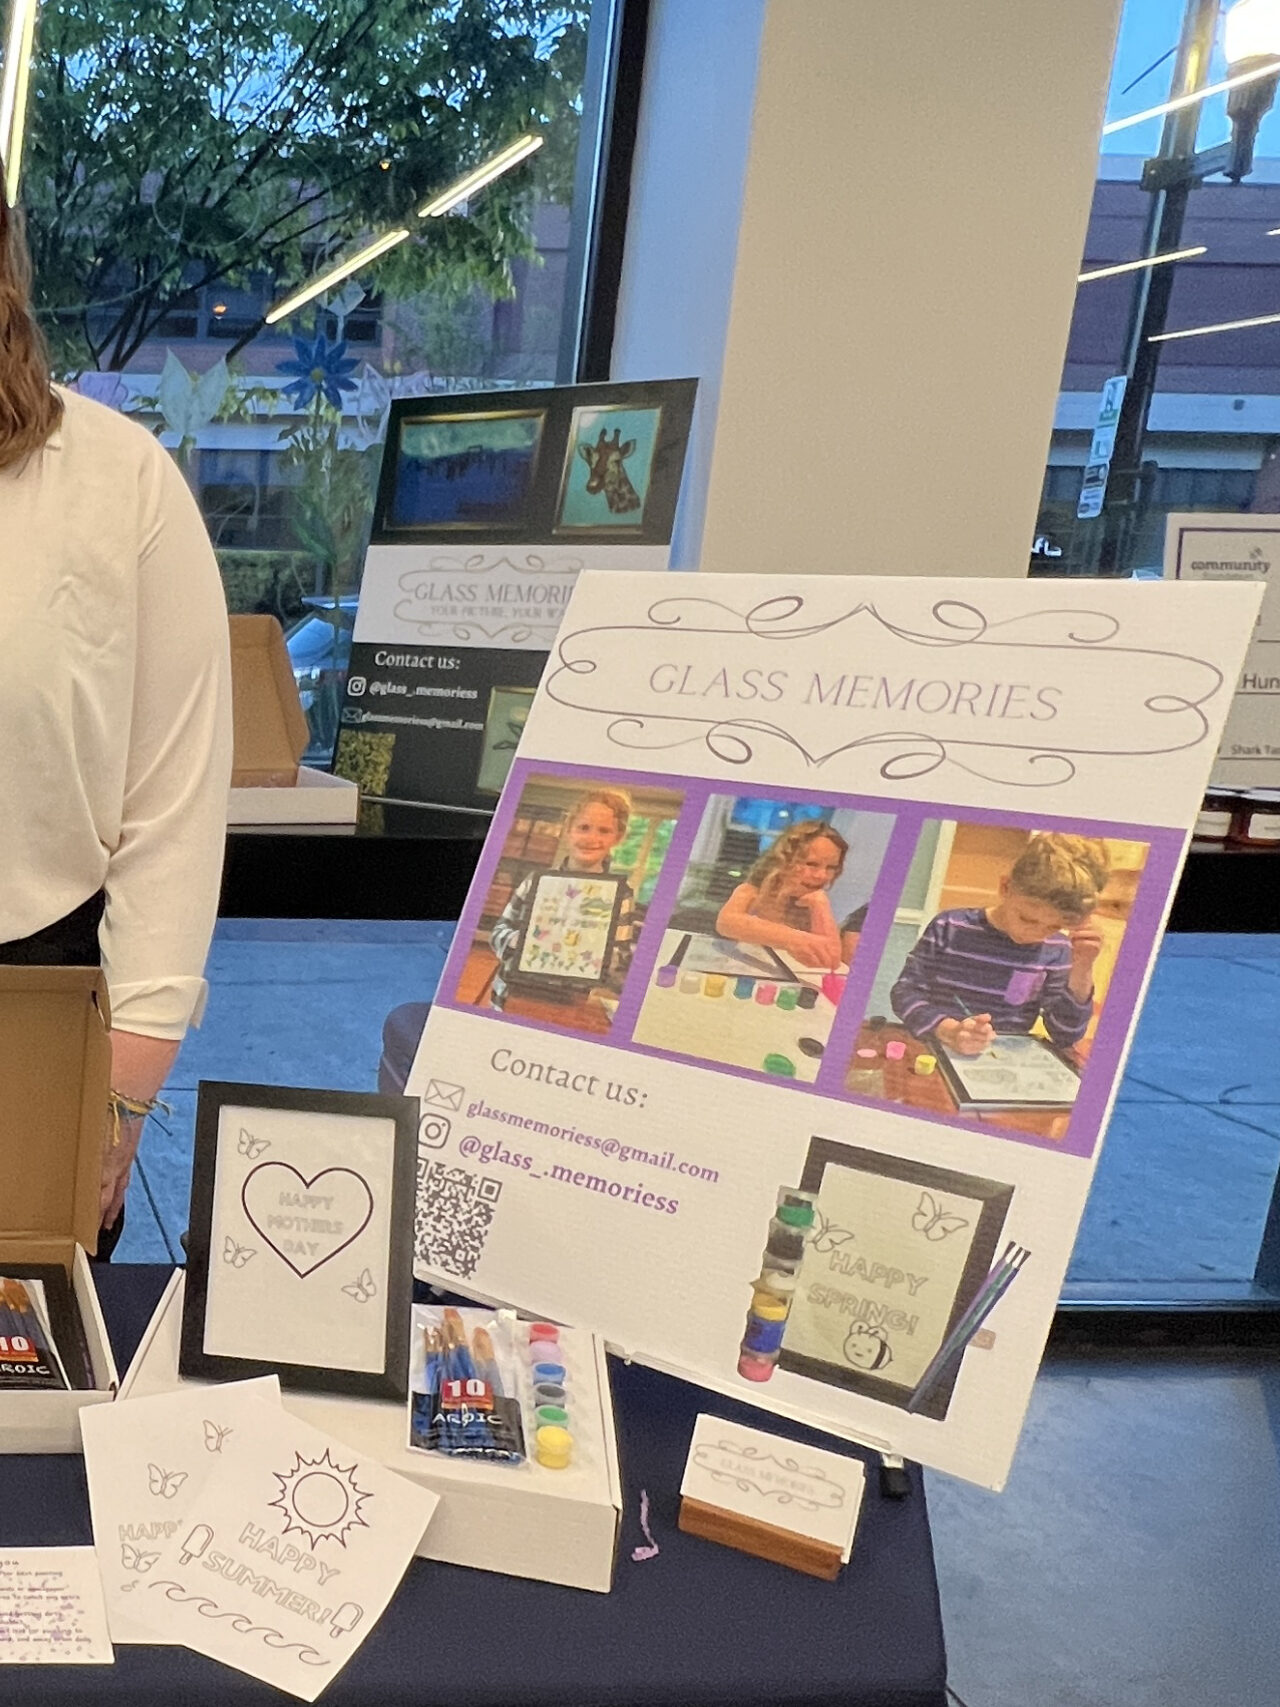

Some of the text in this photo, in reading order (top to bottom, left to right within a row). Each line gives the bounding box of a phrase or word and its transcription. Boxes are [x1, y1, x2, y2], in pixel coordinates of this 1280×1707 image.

[1191, 561, 1271, 574] community
[414, 582, 479, 602] GLASS
[375, 651, 461, 670] Contact us:
[648, 664, 1063, 722] GLASS MEMORIES
[490, 1049, 648, 1108] Contact us:
[466, 1100, 720, 1183] glassmemoriess@gmail.com
[279, 1192, 335, 1211] HAPPY
[267, 1215, 345, 1235] MOTHERS
[283, 1239, 320, 1256] DAY
[829, 1250, 928, 1296] HAPPY
[807, 1282, 920, 1336] SPRING!
[448, 1379, 486, 1397] 10
[118, 1520, 183, 1541] HAPP
[239, 1522, 340, 1586] HAPPY
[201, 1550, 332, 1626] SUMMER!
